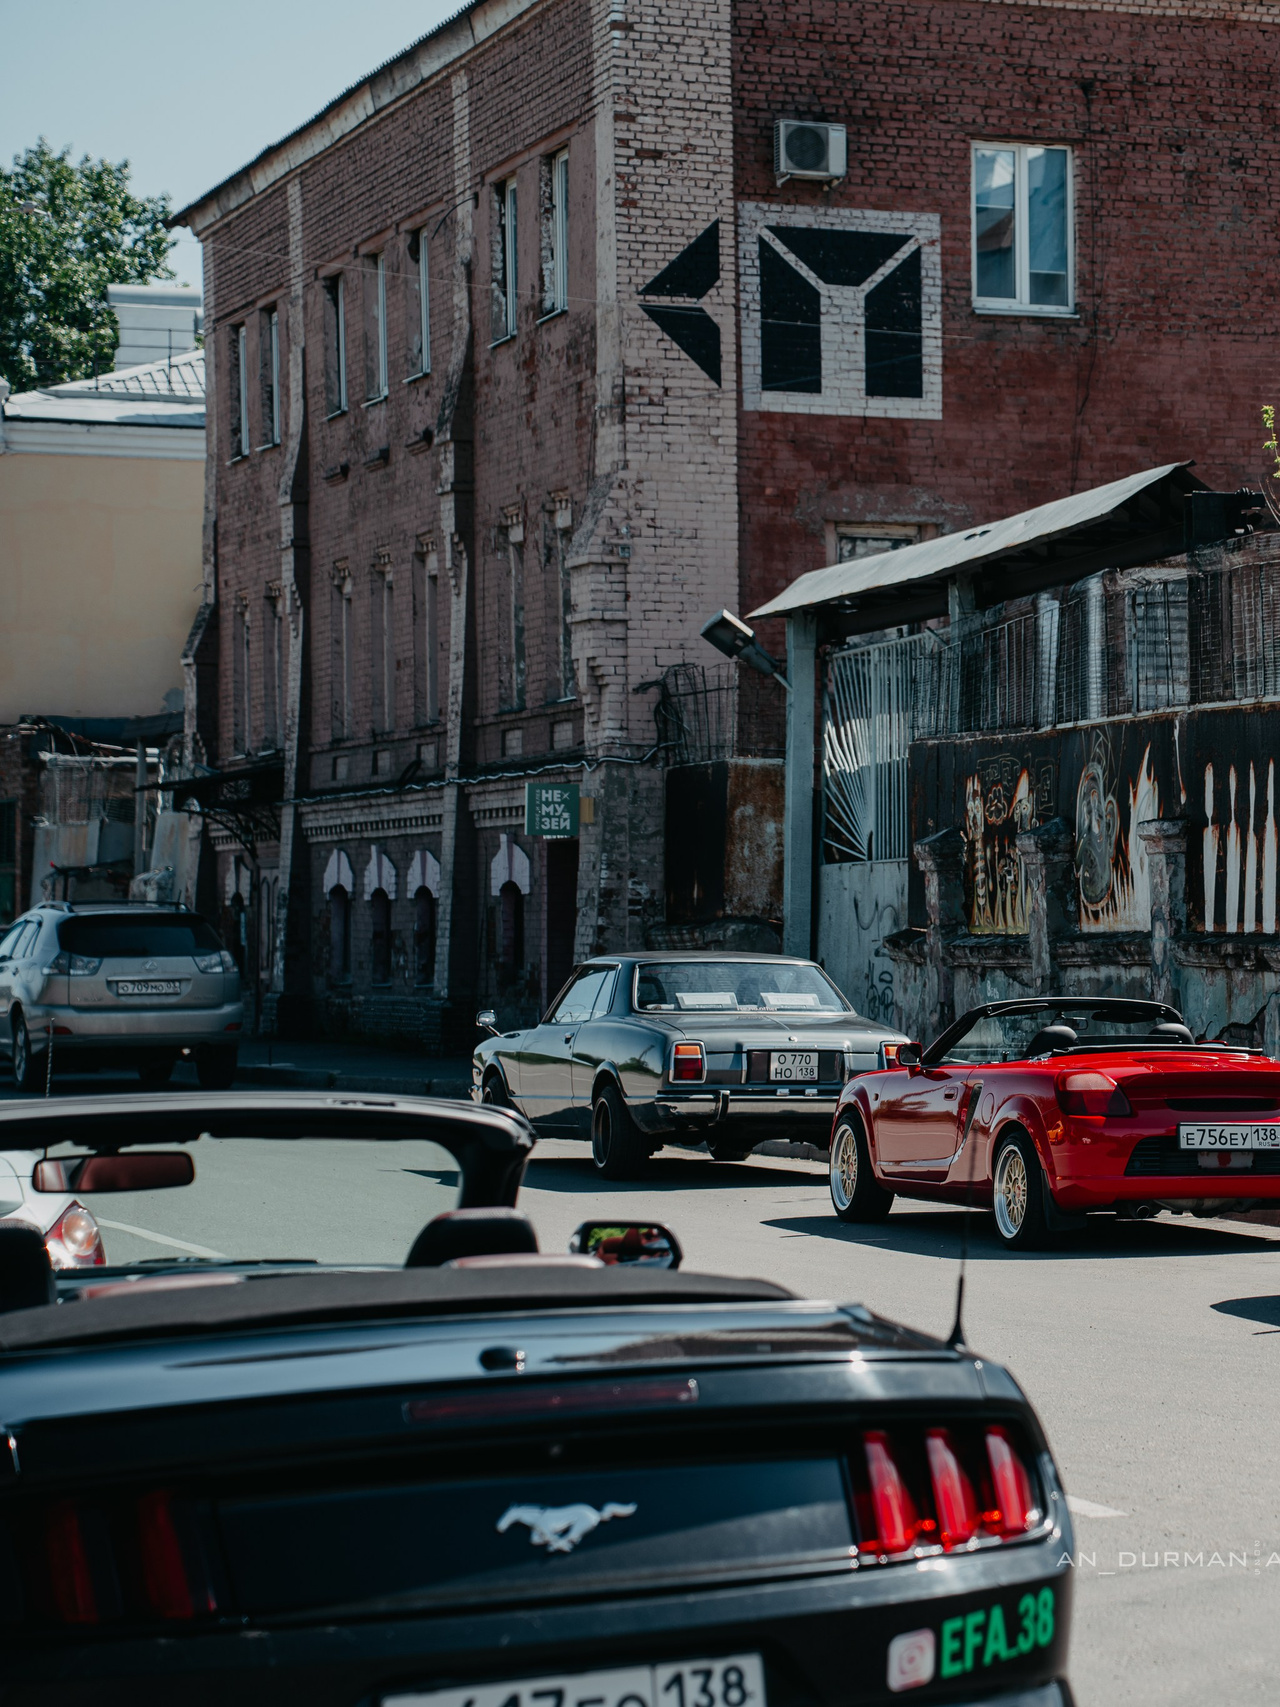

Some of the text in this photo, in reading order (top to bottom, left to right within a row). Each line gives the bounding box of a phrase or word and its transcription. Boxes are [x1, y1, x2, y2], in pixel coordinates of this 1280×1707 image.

[541, 789, 562, 802] НЕ
[541, 803, 565, 816] МУ
[541, 812, 571, 830] ЗЕЙ
[791, 1054, 811, 1065] 770
[774, 1068, 815, 1079] НО 138
[1253, 1128, 1277, 1142] 138
[941, 1586, 1055, 1679] EFA_38
[662, 1665, 748, 1707] 138
